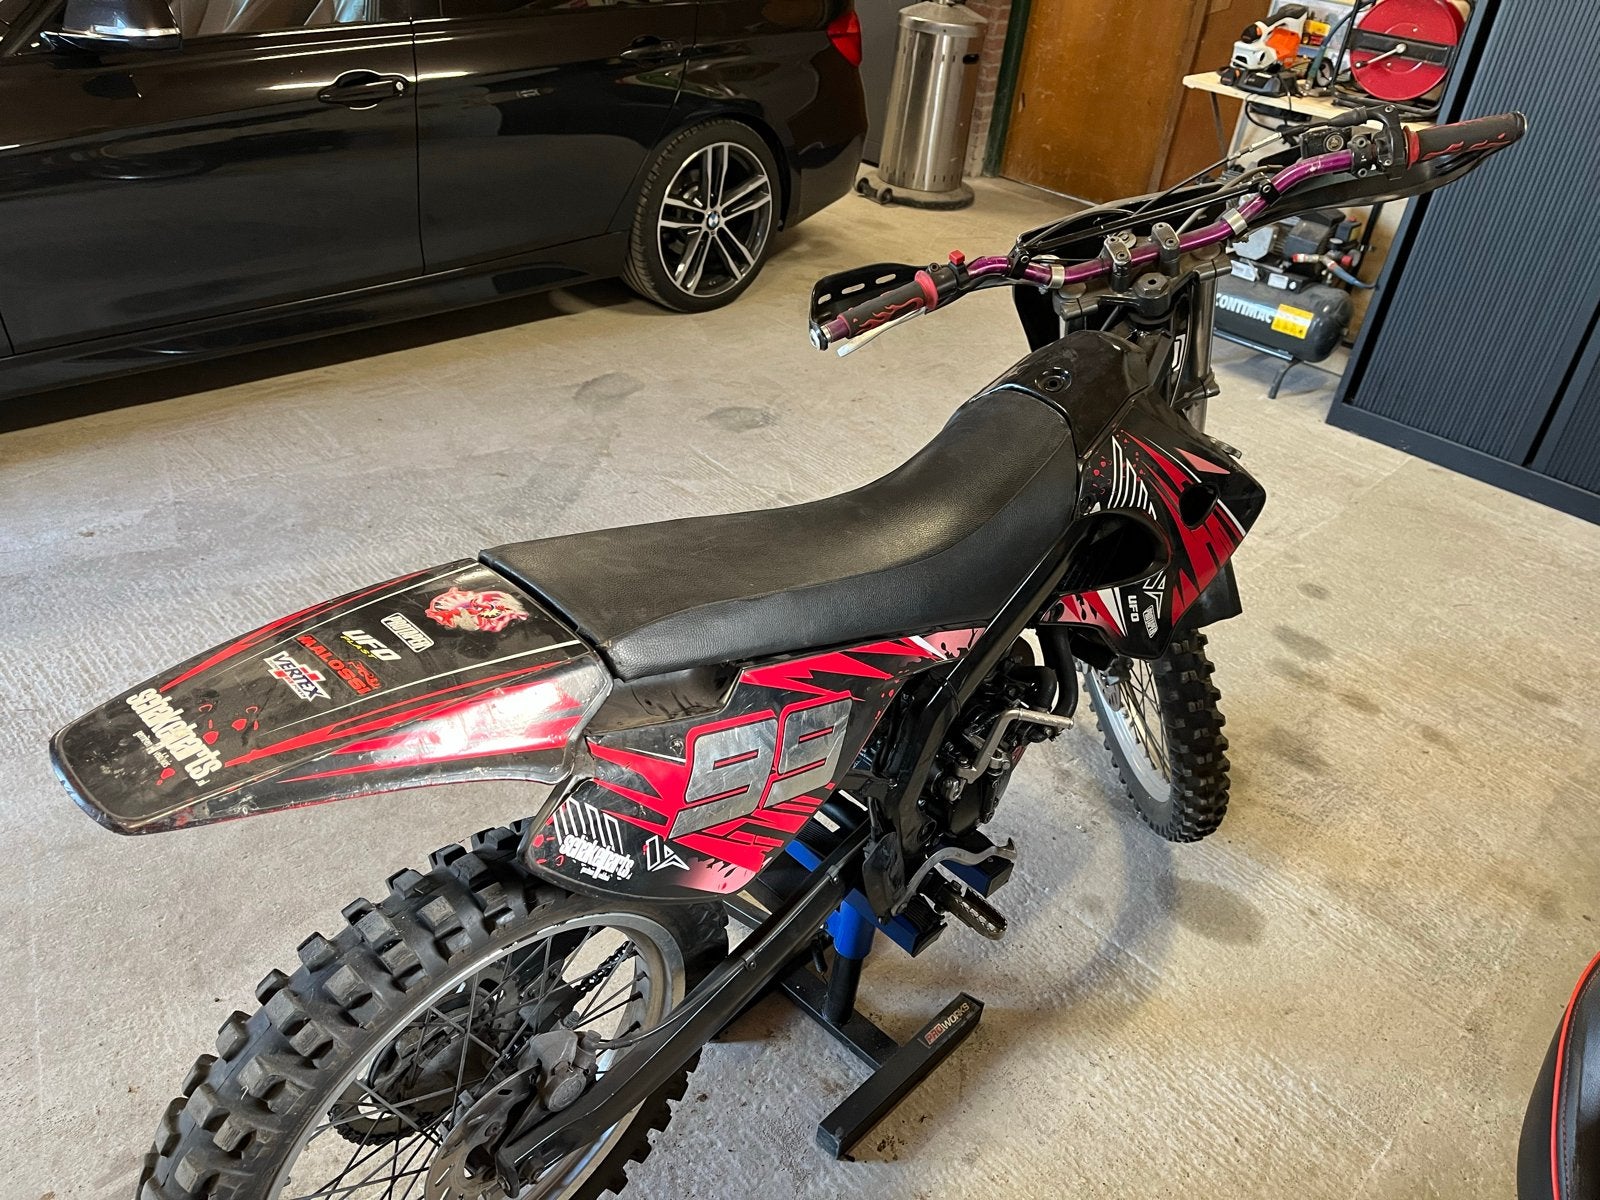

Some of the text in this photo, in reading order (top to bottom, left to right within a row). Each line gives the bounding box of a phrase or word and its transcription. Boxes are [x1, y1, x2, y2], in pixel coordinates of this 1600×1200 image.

[1128, 595, 1139, 622] UFO
[341, 635, 379, 659] PLAST
[342, 630, 401, 660] UFO
[272, 654, 324, 698] VERTEX
[297, 636, 372, 695] MALOSSI
[669, 699, 852, 839] 99
